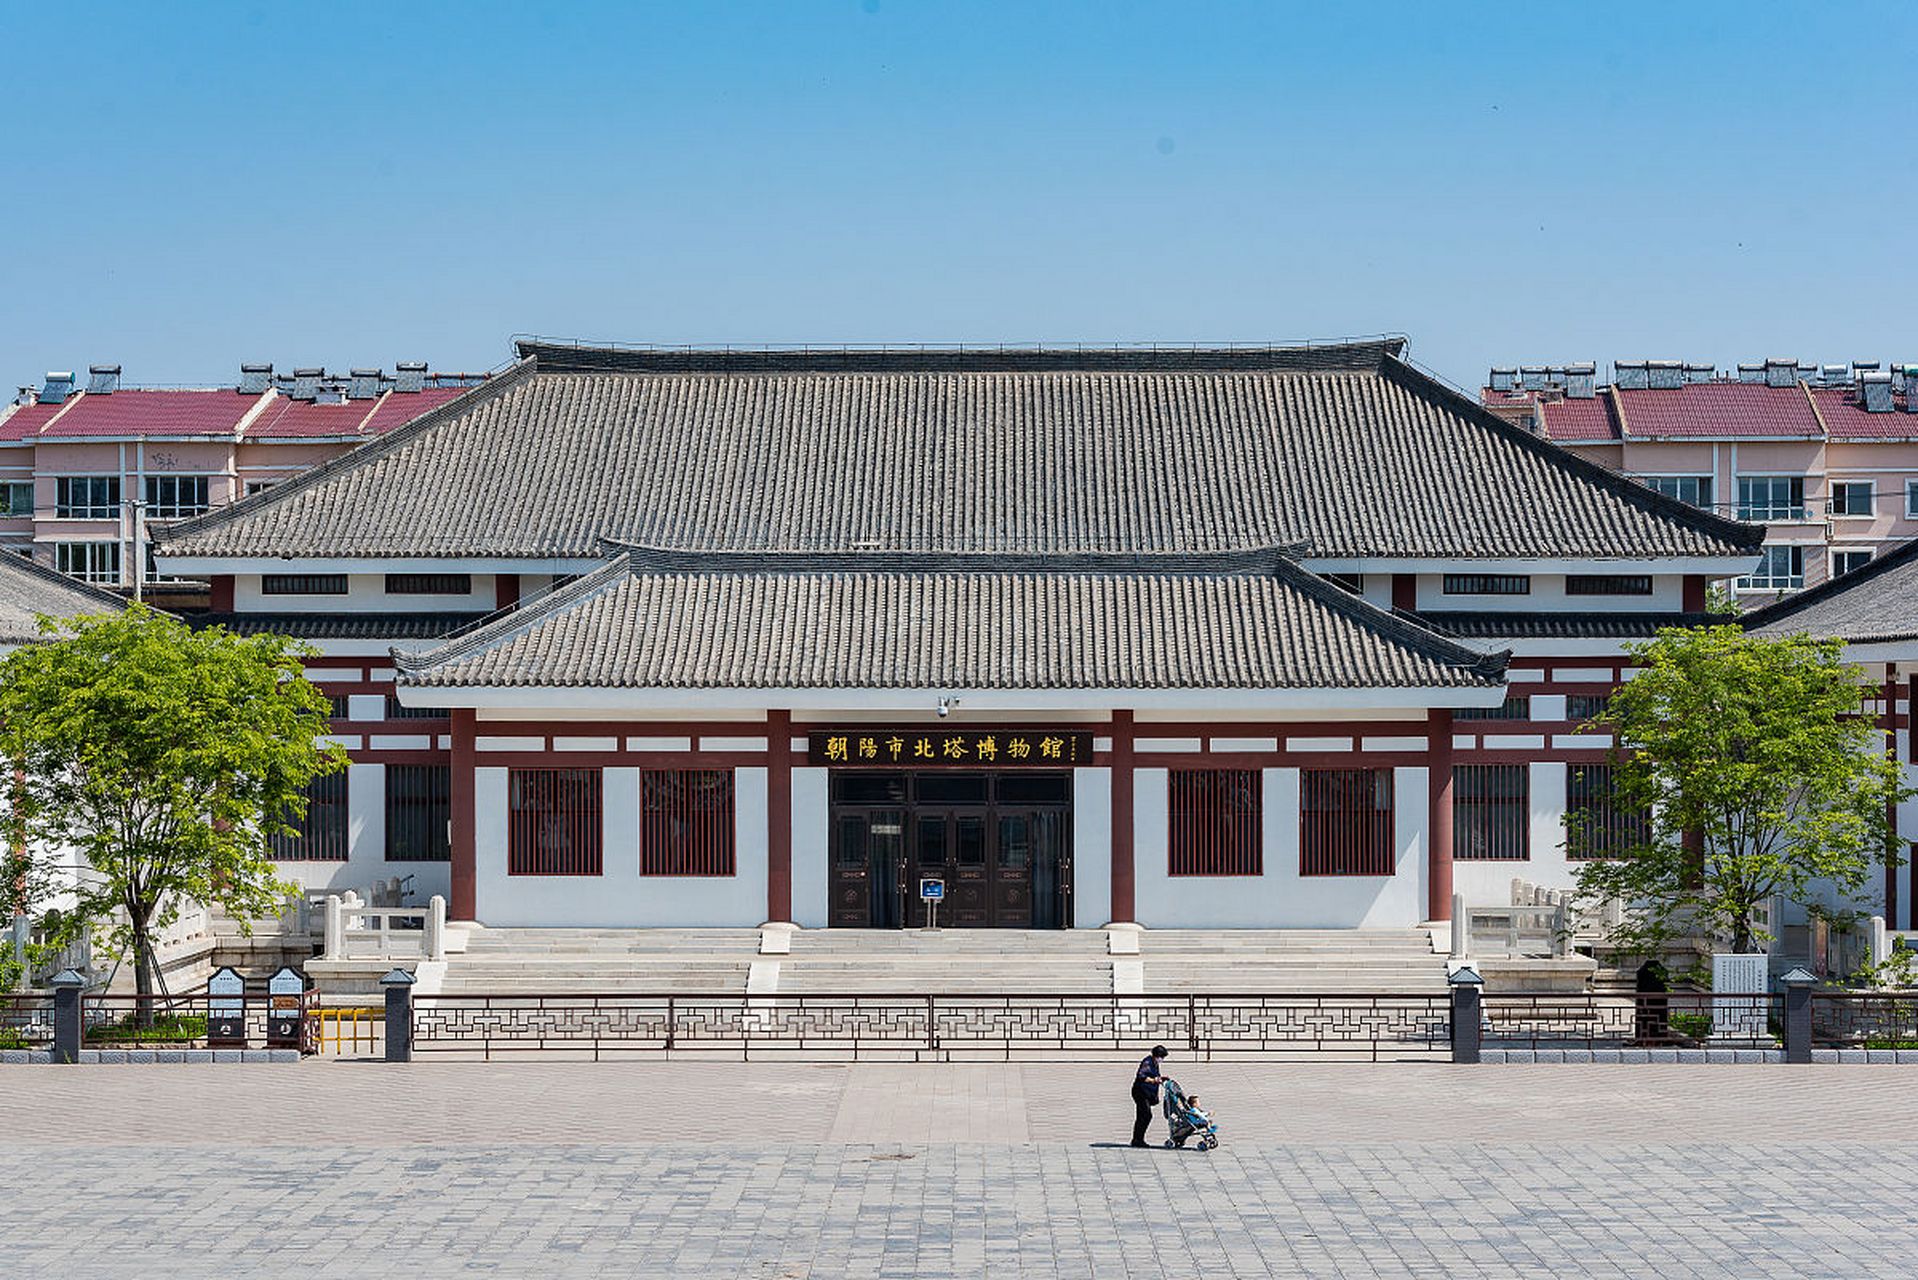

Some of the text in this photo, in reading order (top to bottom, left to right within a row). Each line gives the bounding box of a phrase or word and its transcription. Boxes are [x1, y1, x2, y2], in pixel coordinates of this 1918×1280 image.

[824, 735, 1064, 761] 朝陽市北塔博物館
